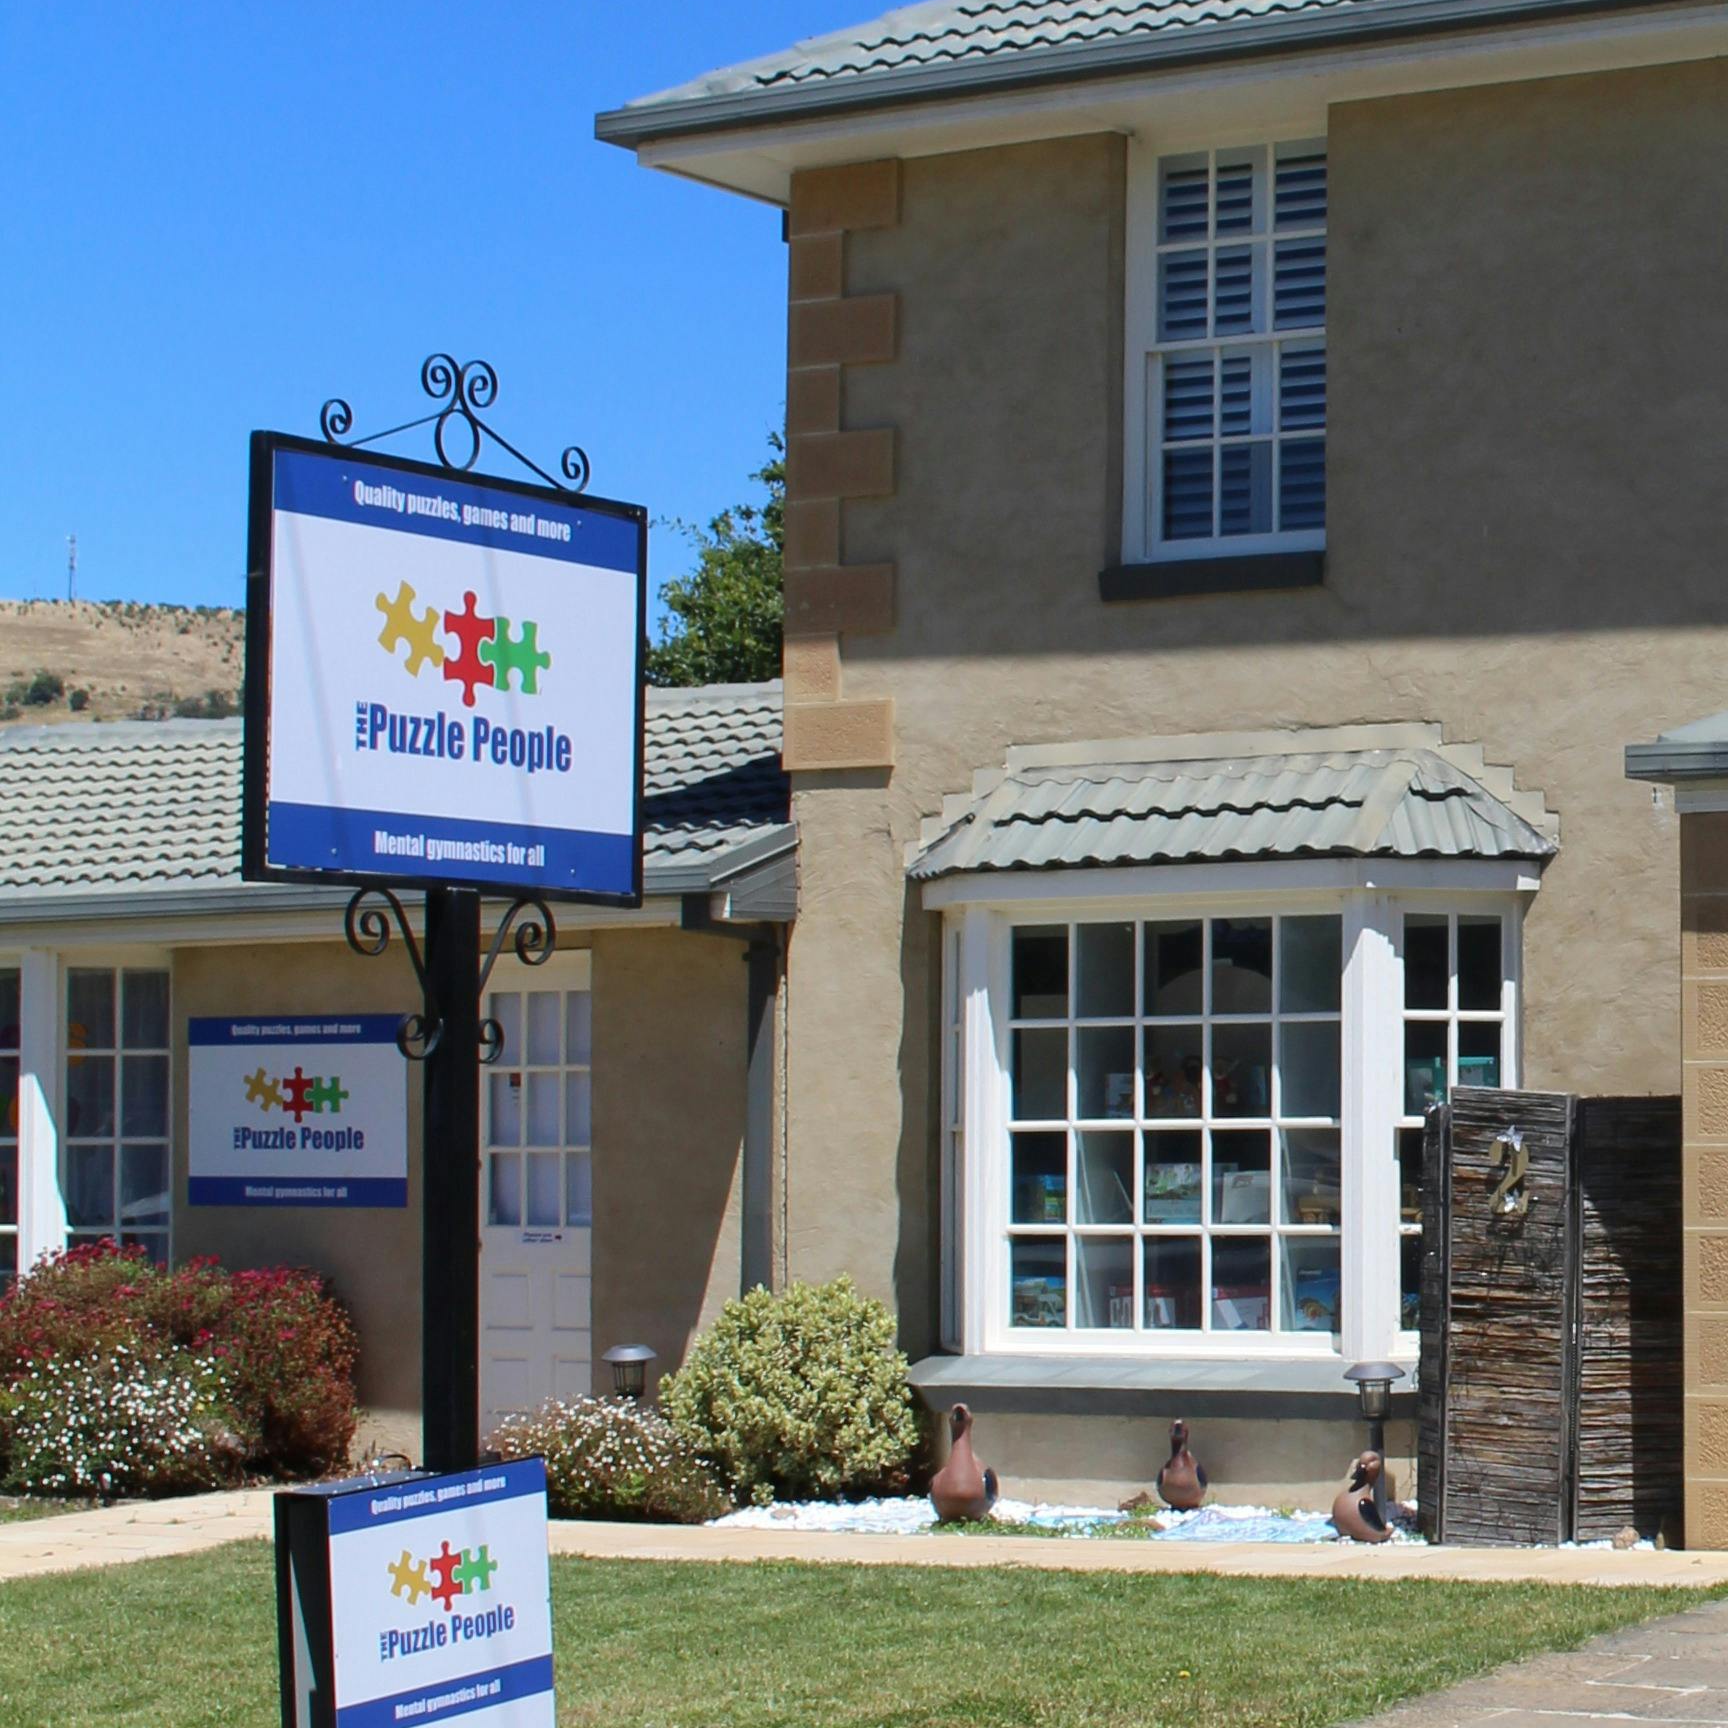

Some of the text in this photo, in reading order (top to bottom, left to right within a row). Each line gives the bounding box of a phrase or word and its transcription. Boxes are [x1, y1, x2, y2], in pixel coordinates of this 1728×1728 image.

[354, 480, 571, 542] Quality puzzles, games and more
[356, 700, 573, 773] THE Puzzle People
[374, 830, 545, 867] Mental gymnastics for all
[232, 1024, 260, 1036] Quality
[294, 1025, 321, 1036] games
[322, 1023, 338, 1034] and
[339, 1024, 361, 1034] more
[241, 1127, 296, 1150] Puzzle
[301, 1127, 364, 1152] People
[1488, 1136, 1530, 1214] 2
[371, 1496, 402, 1515] Quality
[437, 1484, 466, 1502] games
[467, 1479, 483, 1494] and
[484, 1476, 506, 1491] more
[388, 1621, 448, 1659] Puzzle
[452, 1604, 515, 1643] People
[395, 1678, 501, 1719] Mental gymnastics for all
